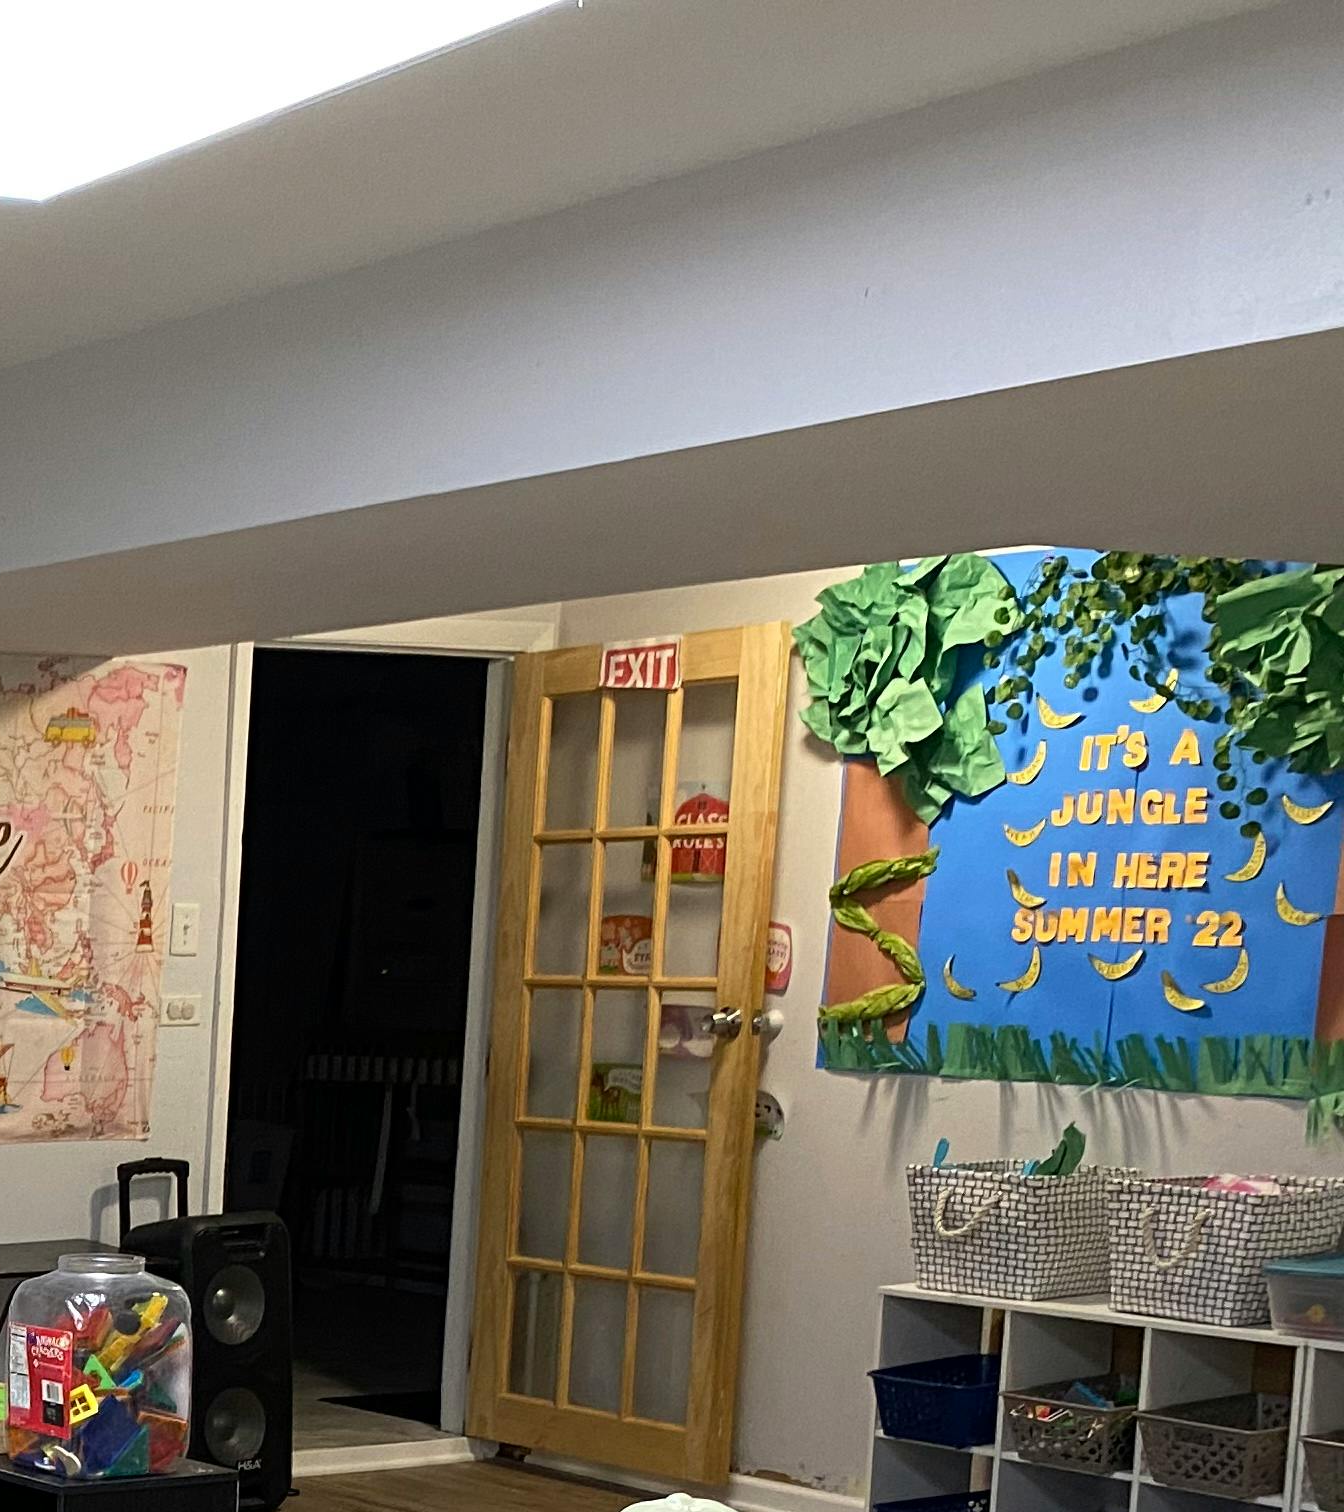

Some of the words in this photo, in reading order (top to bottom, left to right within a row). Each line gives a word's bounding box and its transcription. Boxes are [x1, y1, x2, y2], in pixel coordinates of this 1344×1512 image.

[608, 649, 675, 687] EXIT
[1078, 723, 1149, 772] IT'S
[1168, 727, 1201, 766] A
[1050, 787, 1209, 827] JUNGLE
[1048, 851, 1098, 888] IN
[1113, 852, 1210, 889] HERE
[1011, 906, 1173, 944] SUMMER
[1192, 910, 1244, 947] 22
